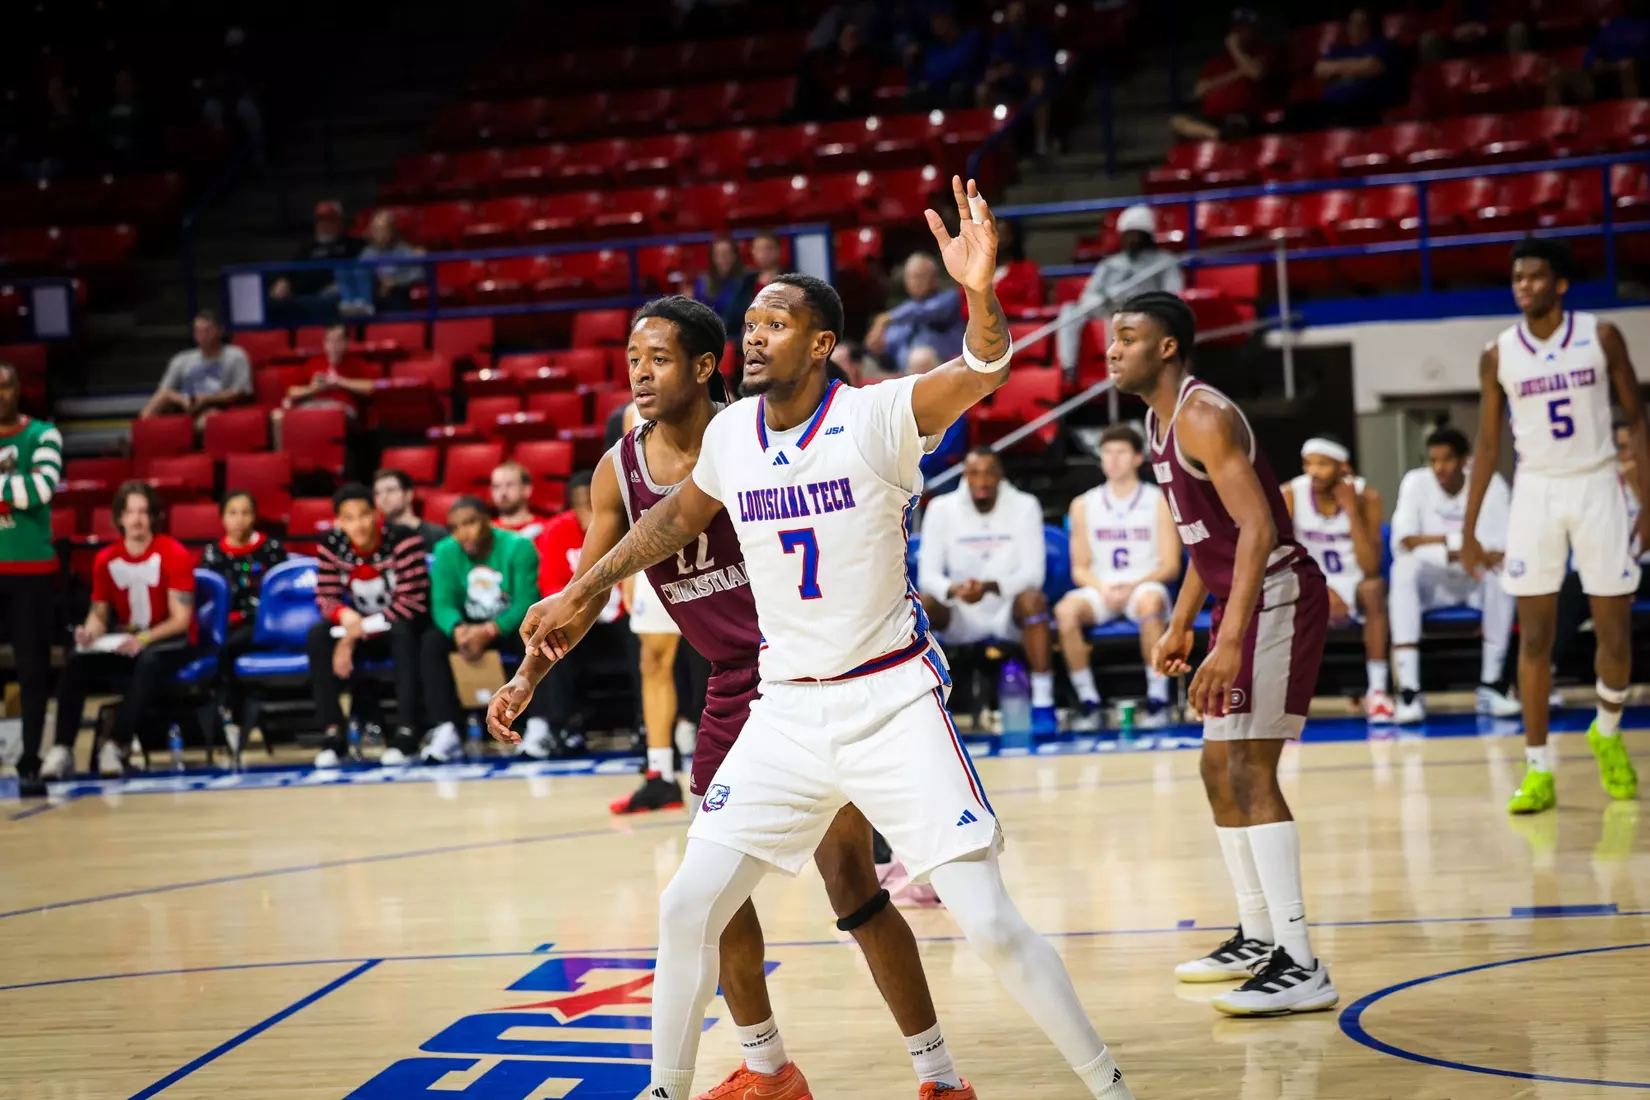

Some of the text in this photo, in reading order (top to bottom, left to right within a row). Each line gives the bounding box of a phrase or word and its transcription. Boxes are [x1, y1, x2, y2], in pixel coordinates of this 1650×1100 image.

[824, 425, 845, 436] USA
[1547, 398, 1575, 440] 5
[737, 477, 856, 523] LOUISIANA TECH
[778, 527, 823, 600] 7
